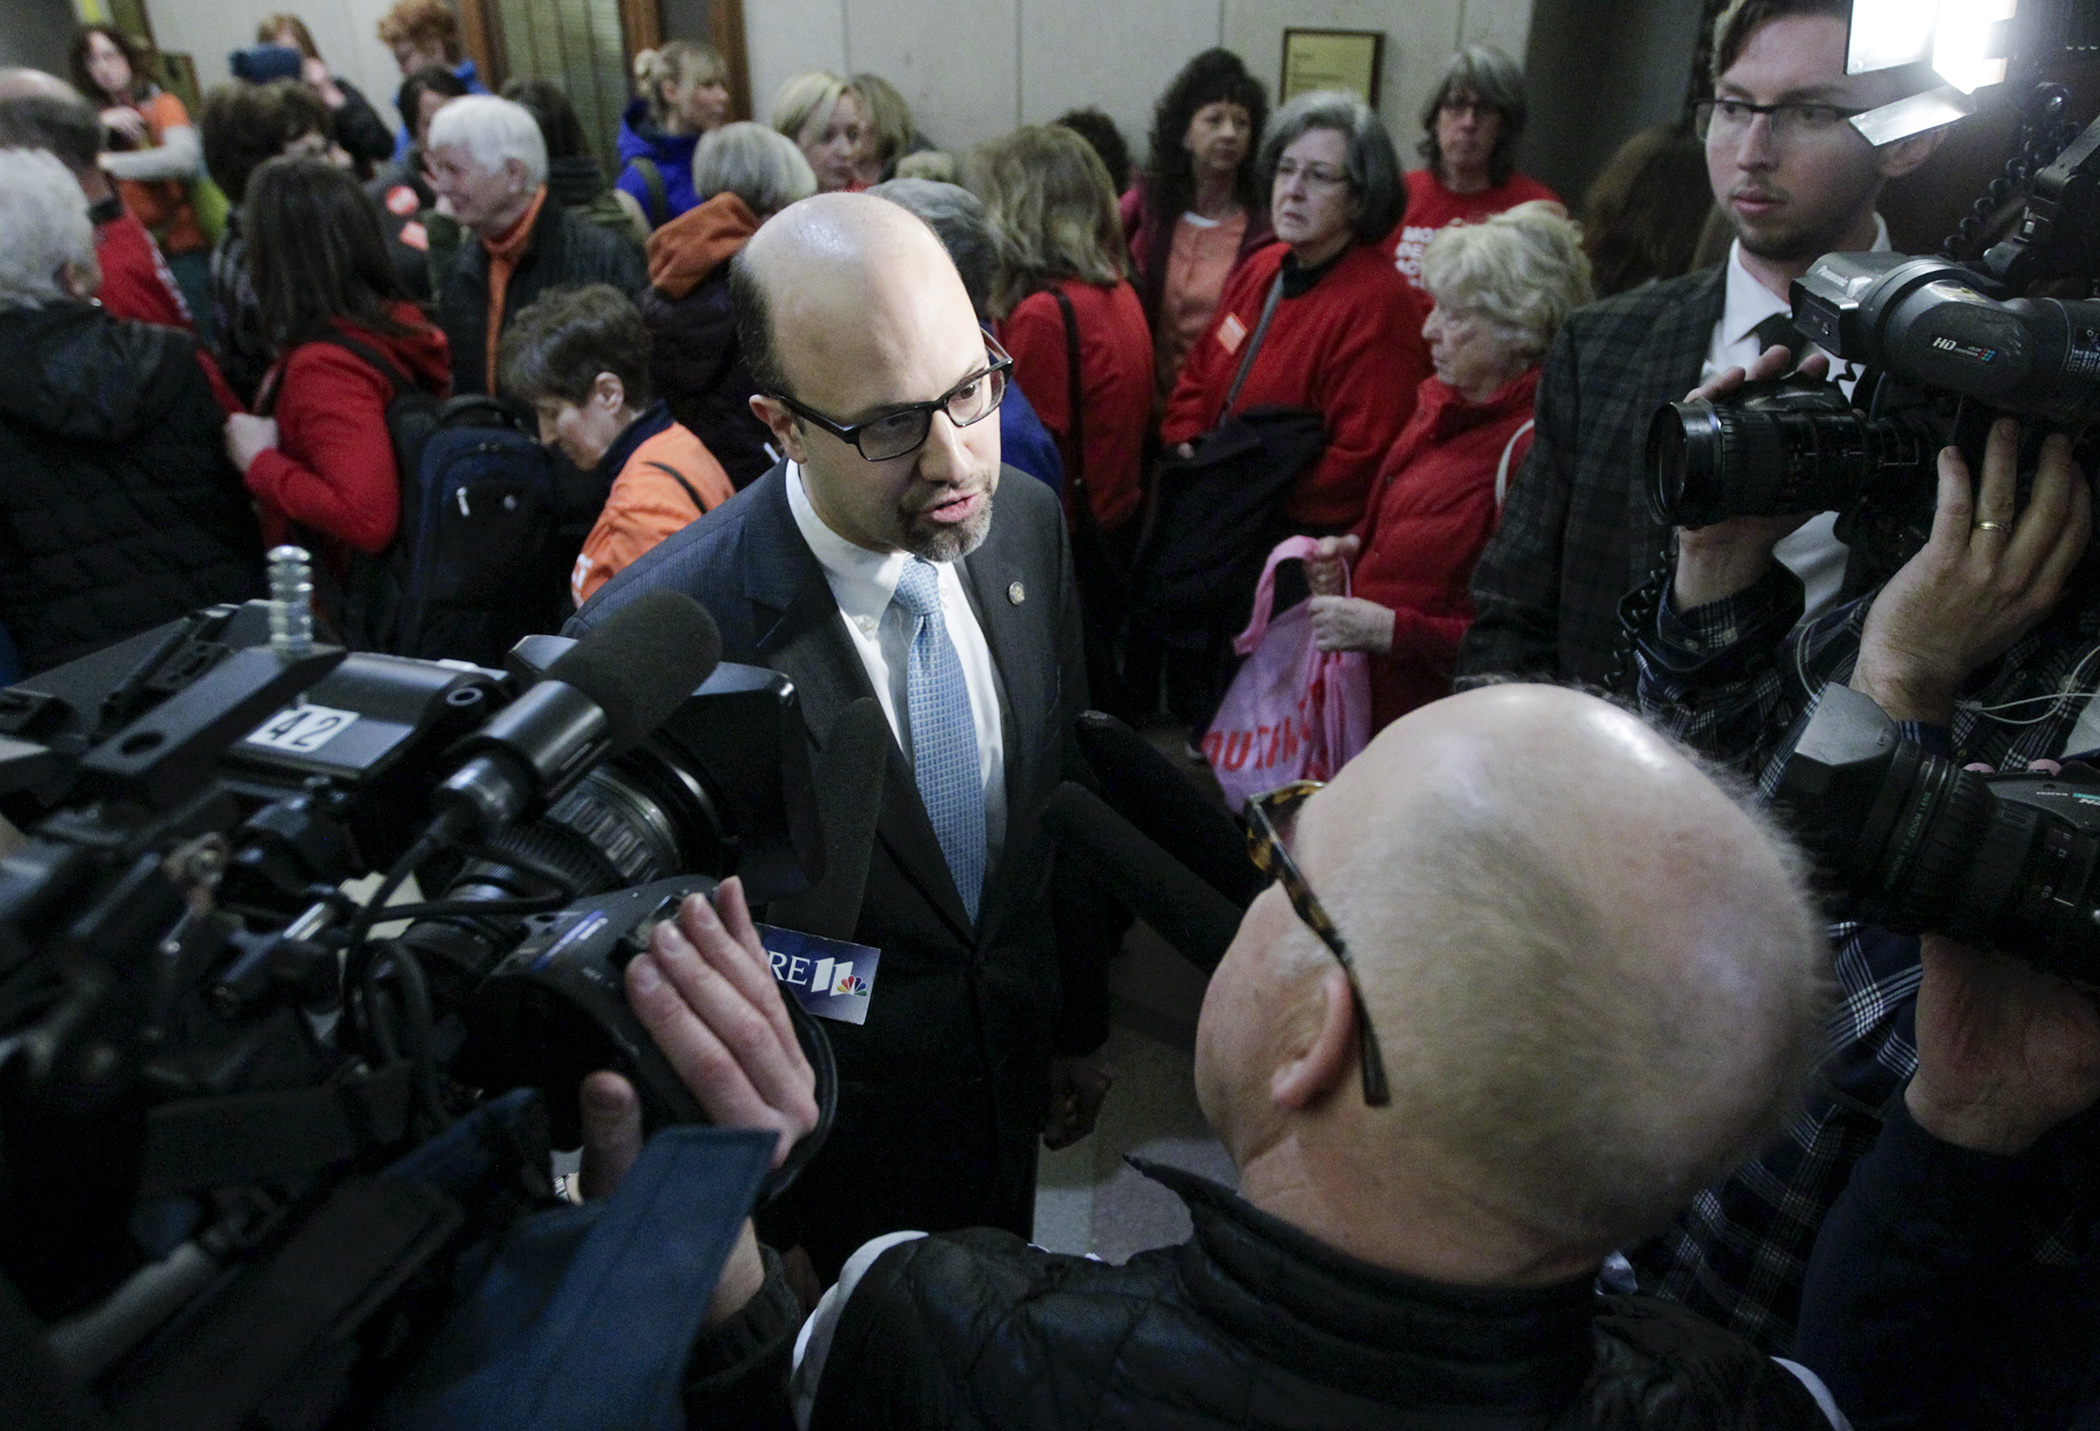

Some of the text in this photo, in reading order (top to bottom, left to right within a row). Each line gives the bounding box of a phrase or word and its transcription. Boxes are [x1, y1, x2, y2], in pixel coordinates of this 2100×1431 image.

[1932, 336, 1957, 351] HD
[268, 711, 342, 747] 42
[1907, 813, 1923, 838] ZOOM
